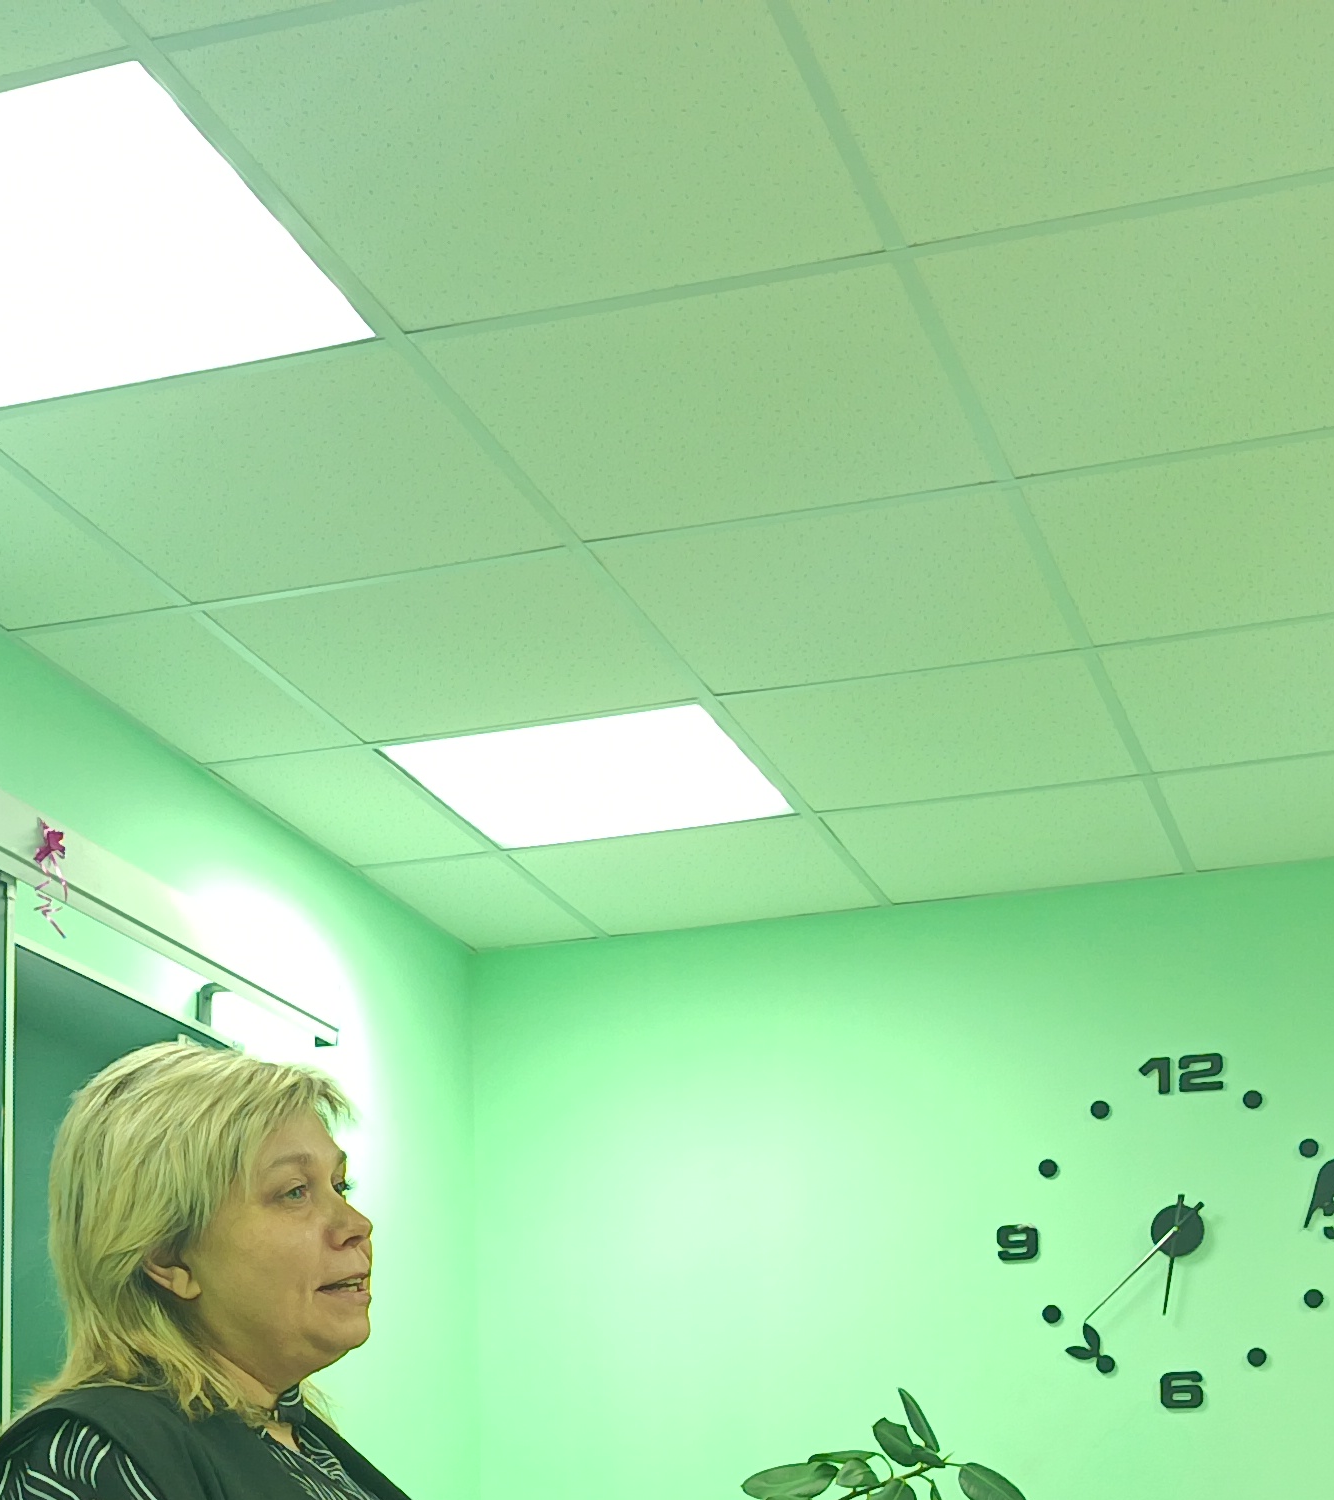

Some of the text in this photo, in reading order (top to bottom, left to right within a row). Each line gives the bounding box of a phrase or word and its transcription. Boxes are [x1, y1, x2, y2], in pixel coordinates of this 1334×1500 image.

[1139, 1053, 1224, 1094] 12
[997, 1225, 1038, 1261] 9
[1160, 1371, 1203, 1408] 6
